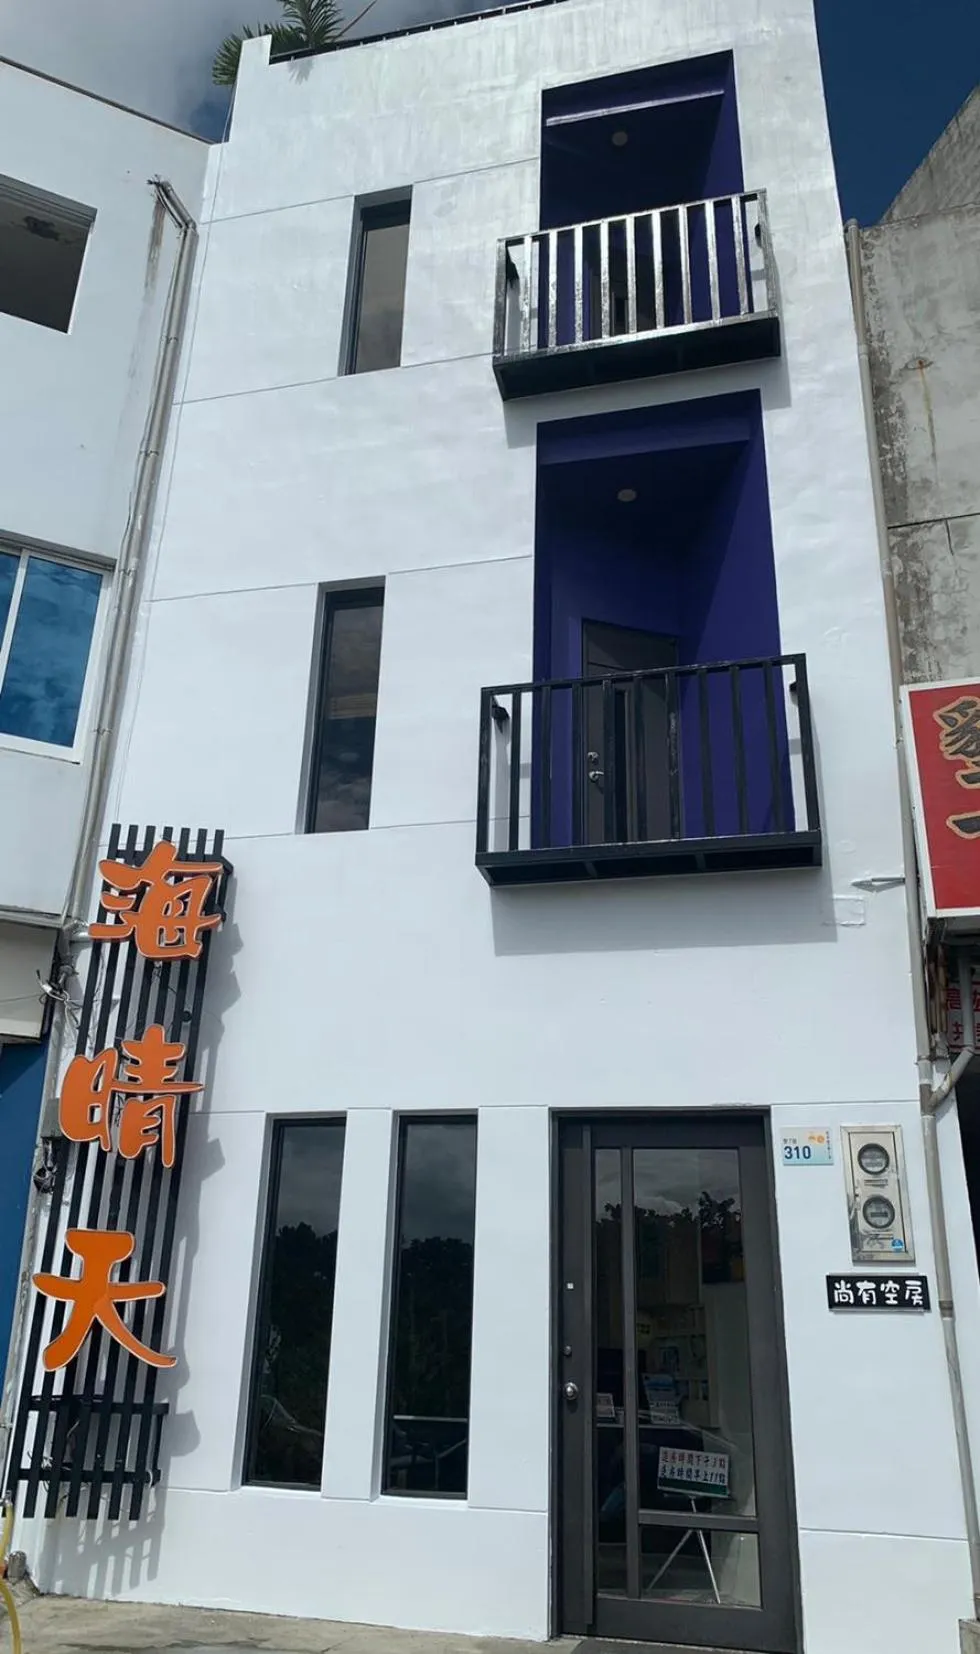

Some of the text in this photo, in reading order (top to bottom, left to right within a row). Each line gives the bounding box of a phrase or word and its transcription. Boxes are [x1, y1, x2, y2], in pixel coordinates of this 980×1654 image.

[33, 840, 223, 1371] 海晴天
[784, 1145, 811, 1160] 310
[833, 1280, 923, 1305] 尚有空房
